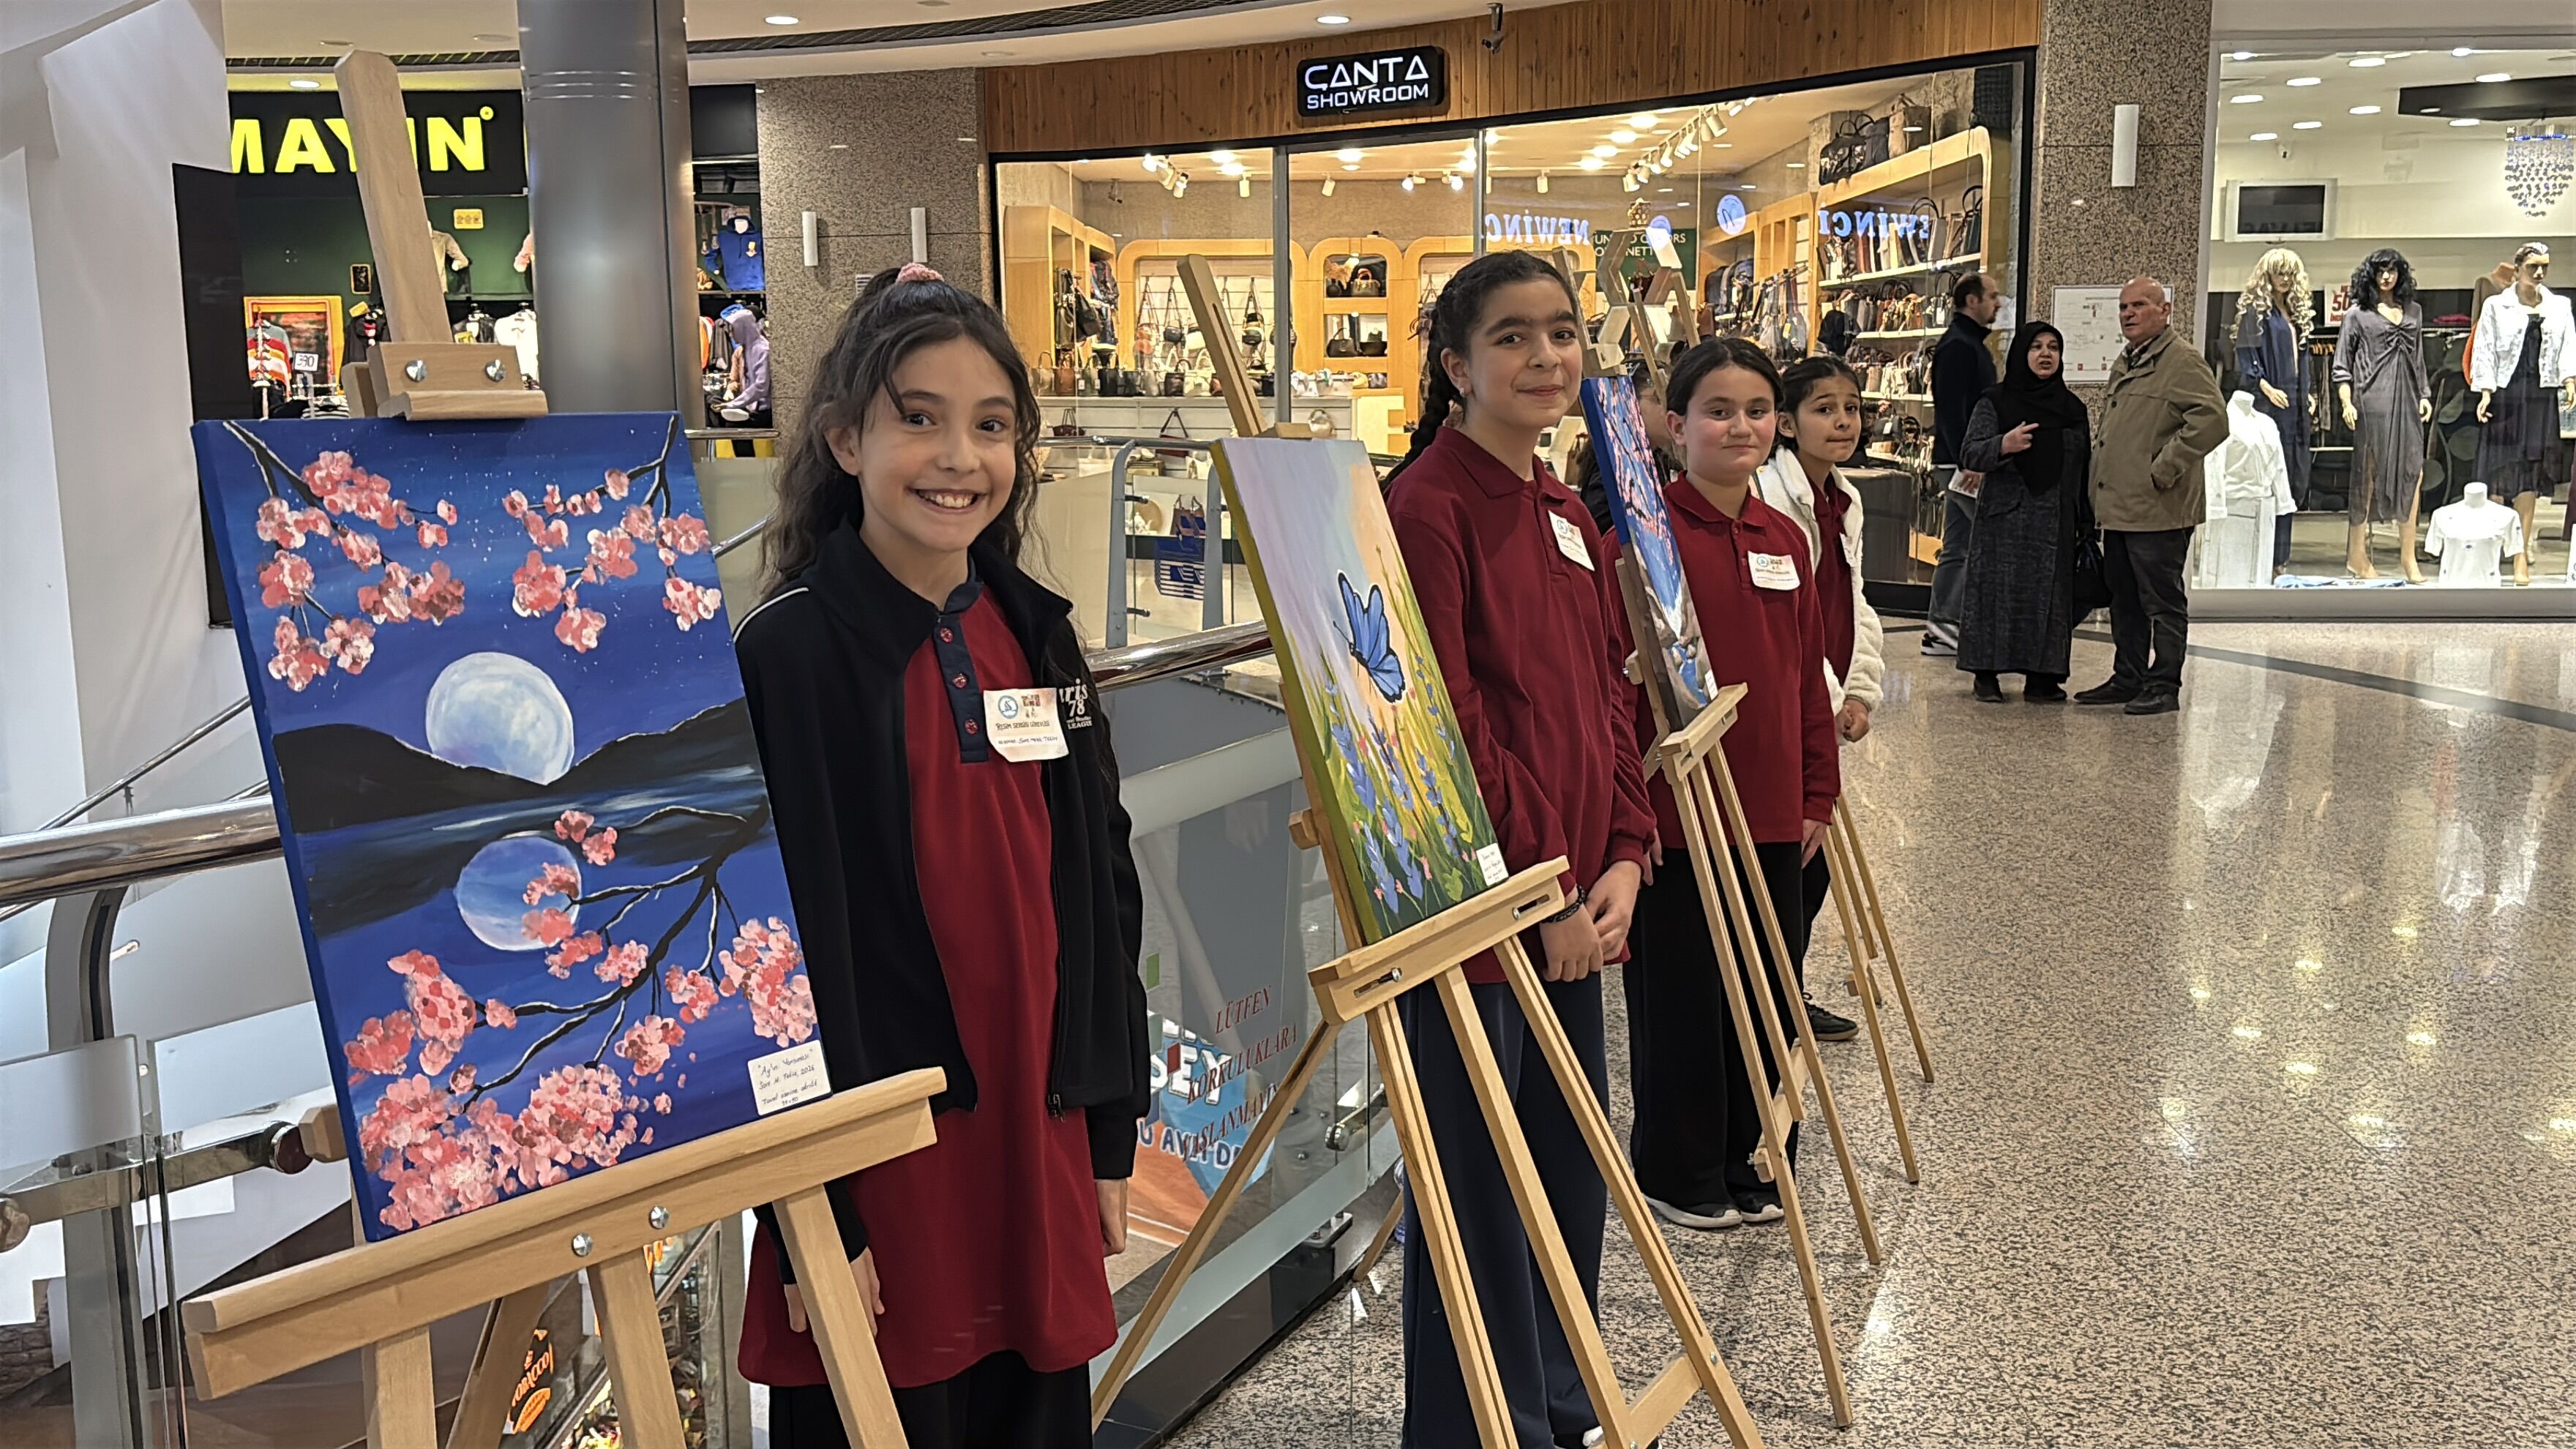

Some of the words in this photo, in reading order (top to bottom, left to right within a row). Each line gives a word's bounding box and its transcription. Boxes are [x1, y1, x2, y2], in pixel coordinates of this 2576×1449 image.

[1307, 83, 1429, 110] SHOWROOM
[1068, 699, 1085, 717] 78
[1216, 984, 1272, 1034] LÜTFEN
